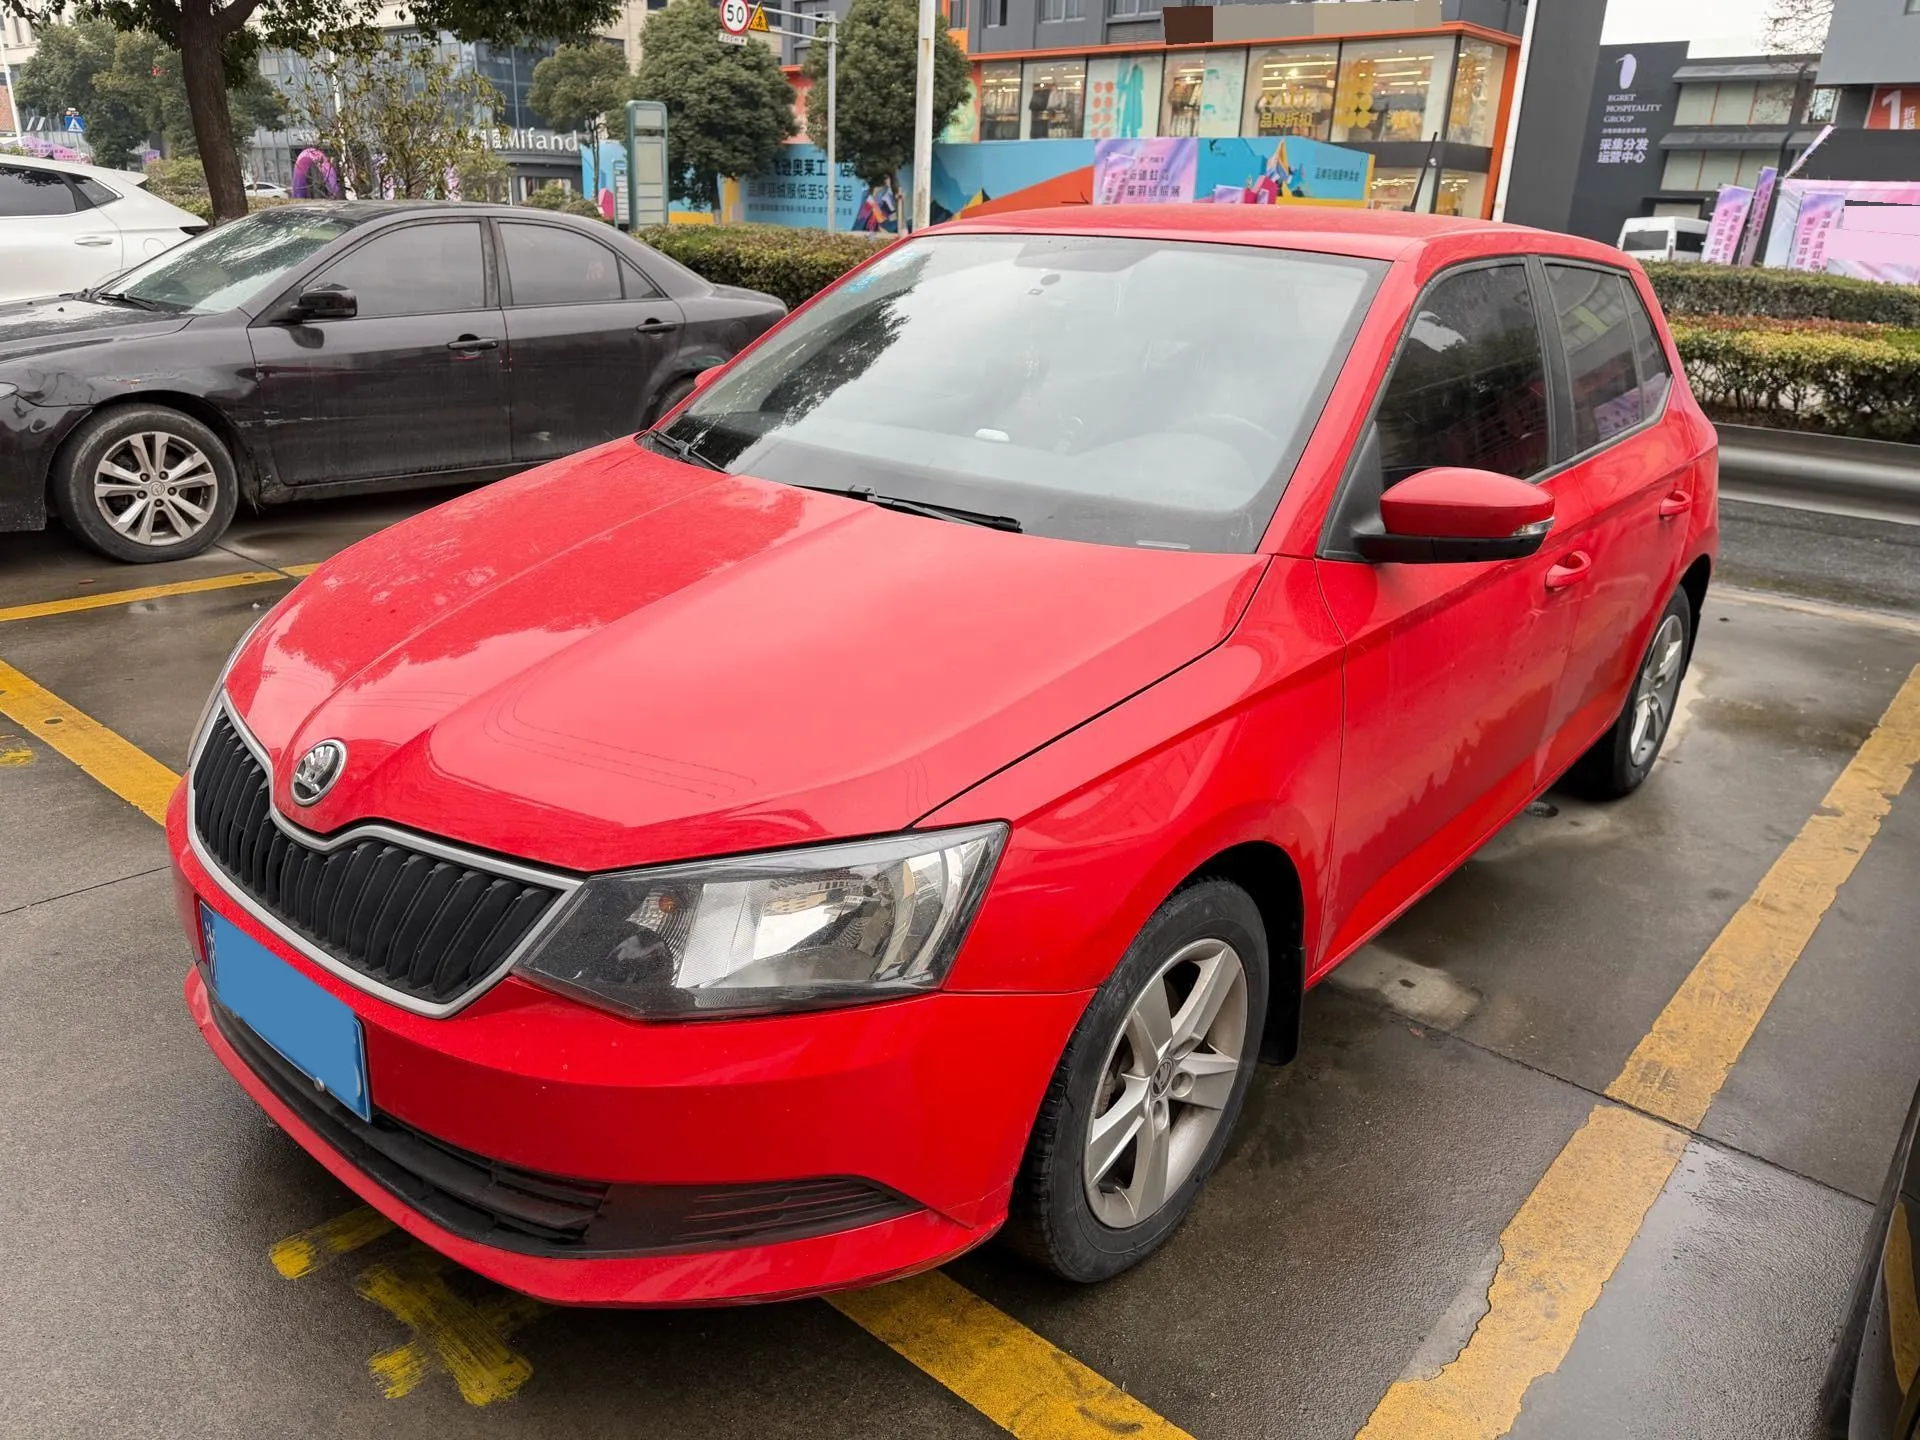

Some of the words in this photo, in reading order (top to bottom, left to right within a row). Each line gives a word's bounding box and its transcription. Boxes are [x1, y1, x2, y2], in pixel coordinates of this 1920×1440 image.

[726, 4, 745, 23] 50
[1607, 93, 1636, 102] EGRET
[1605, 103, 1662, 113] HOSPITALITY
[1603, 115, 1634, 123] GROUP
